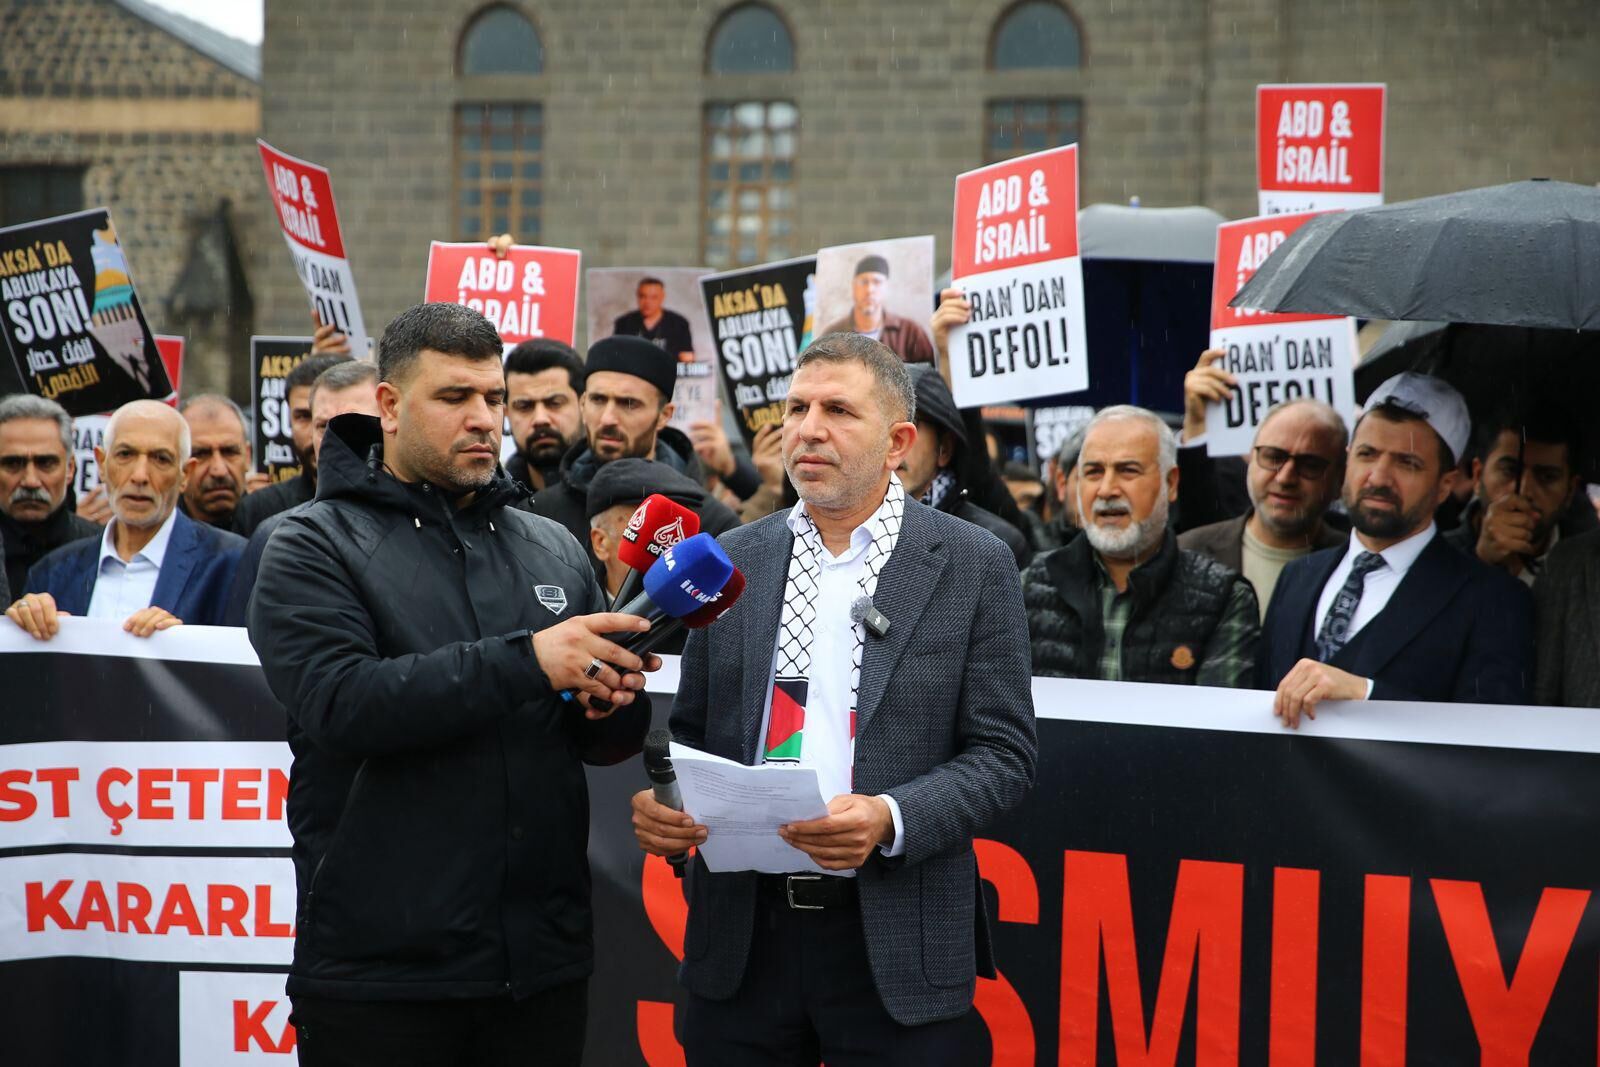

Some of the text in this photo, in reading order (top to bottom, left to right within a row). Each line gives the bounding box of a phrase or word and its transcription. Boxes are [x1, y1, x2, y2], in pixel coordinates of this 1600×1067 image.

[1276, 100, 1353, 138] ABD &
[1276, 138, 1352, 184] İSRAİL
[300, 174, 319, 209] &
[976, 169, 1050, 220] ABD &
[974, 208, 1051, 265] İSRAİL
[1, 265, 81, 301] ABLUKAYA
[457, 256, 545, 295] ABD &
[8, 287, 94, 344] SON!
[458, 290, 544, 337] RAİL
[713, 282, 788, 318] AKSA'DA
[718, 306, 793, 340] ABLUKAYA
[721, 326, 797, 381] SON!
[967, 317, 1070, 378] DEFOL!
[25, 880, 296, 937] KARARL
